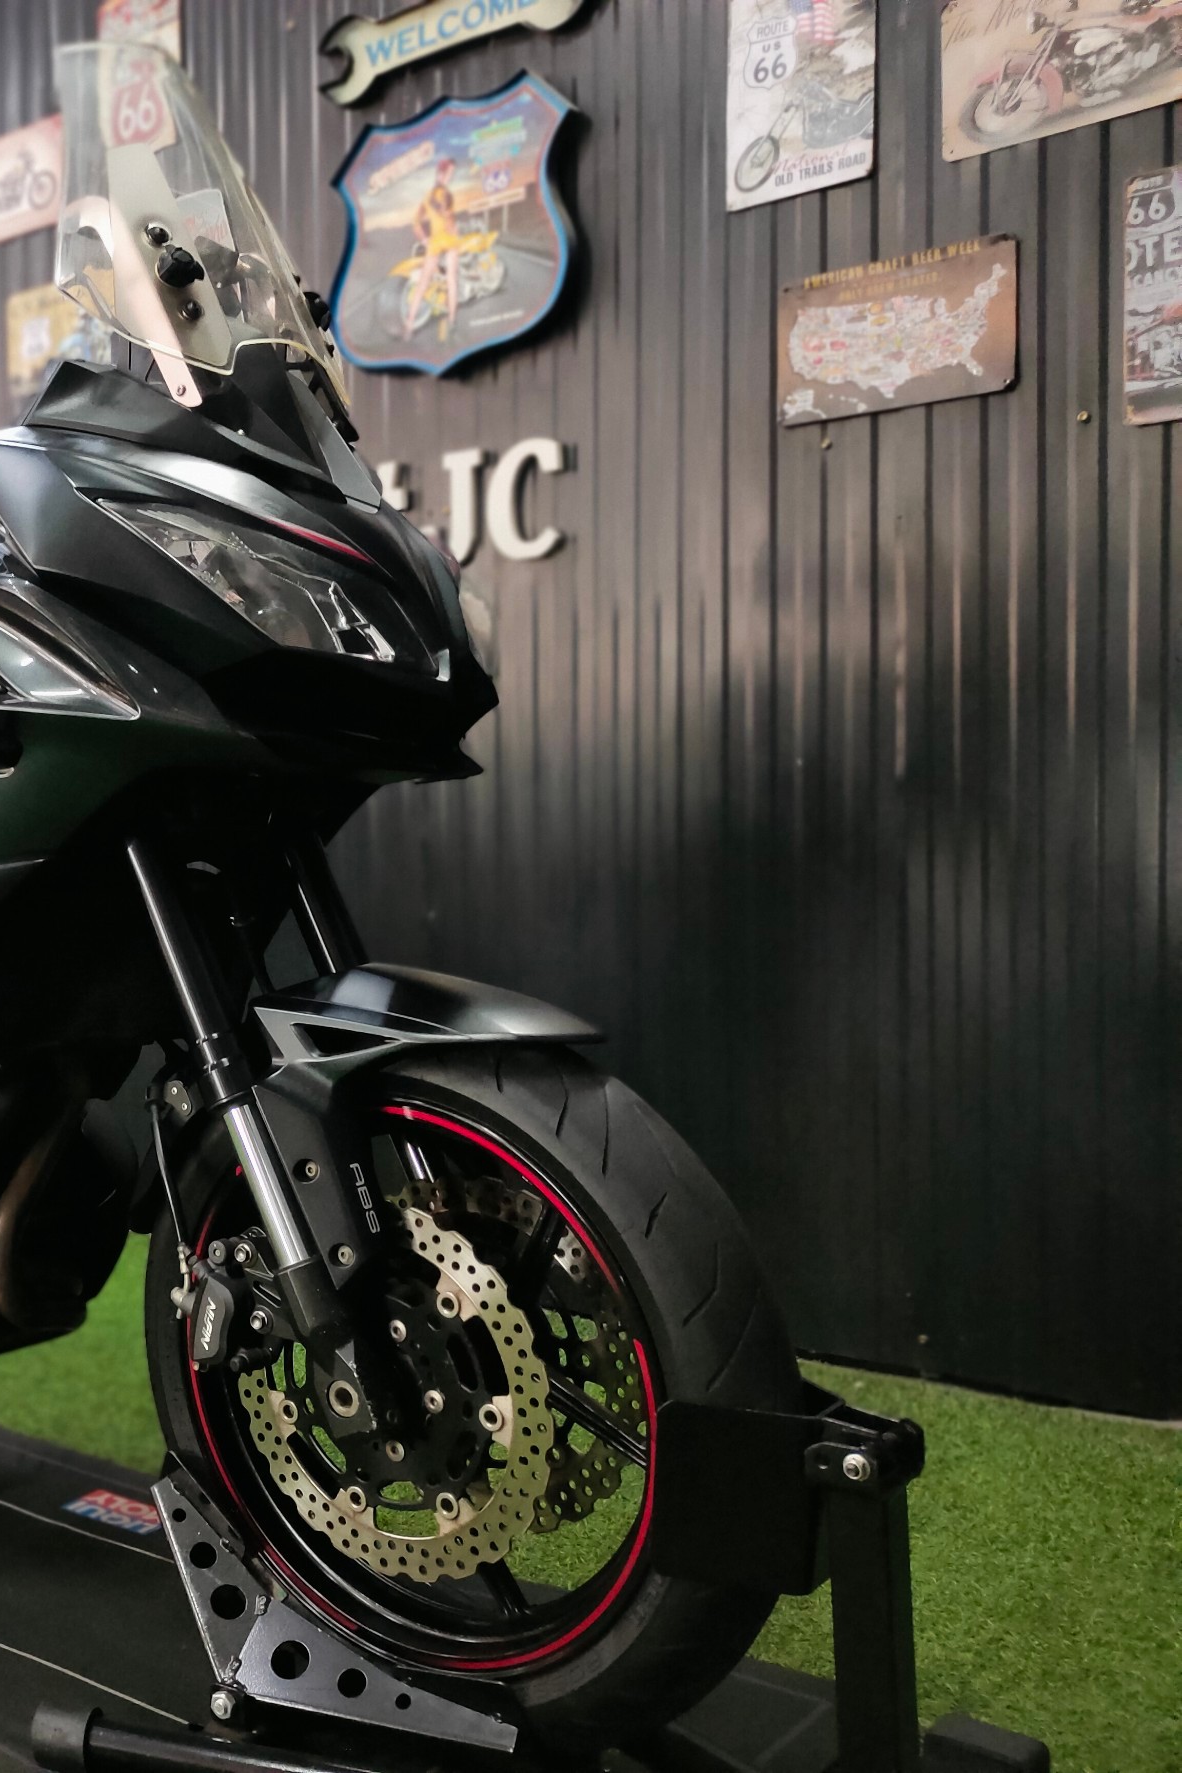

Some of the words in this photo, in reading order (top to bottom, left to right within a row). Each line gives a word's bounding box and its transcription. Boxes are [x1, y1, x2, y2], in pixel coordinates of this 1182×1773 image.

[756, 21, 789, 39] ROUTE
[754, 53, 787, 84] 66
[117, 84, 157, 140] 66
[774, 171, 794, 187] OLD
[799, 161, 833, 180] TRAILS
[838, 152, 867, 170] ROAD
[1127, 193, 1166, 225] 66
[804, 266, 864, 289] AMERICAN
[868, 256, 906, 275] CRAFT
[911, 248, 942, 266] BEER
[948, 240, 980, 258] WEEK
[349, 1163, 380, 1234] ABS
[200, 1296, 216, 1351] NISSIN
